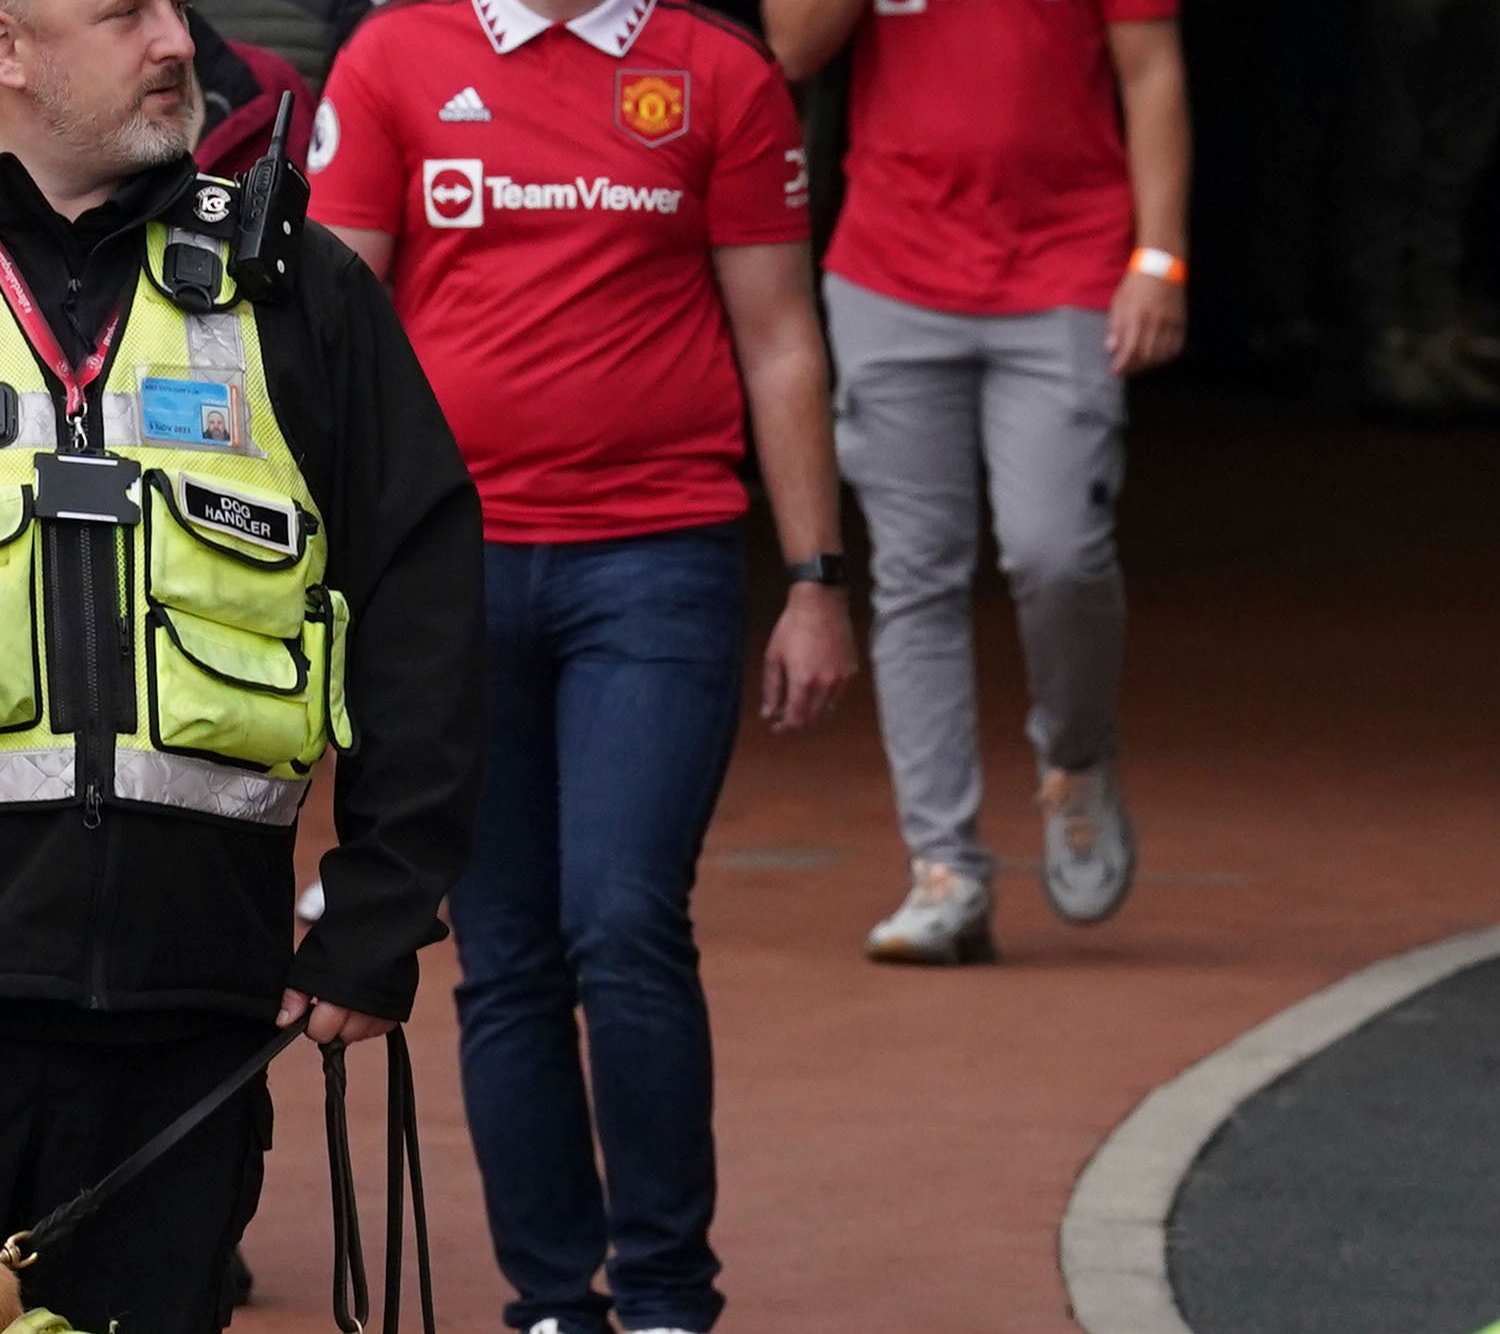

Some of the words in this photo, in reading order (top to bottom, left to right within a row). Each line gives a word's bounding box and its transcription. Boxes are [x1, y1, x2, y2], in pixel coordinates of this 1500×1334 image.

[484, 176, 684, 215] TeamViewer
[205, 505, 271, 538] HANDLER
[220, 497, 251, 517] DOG
